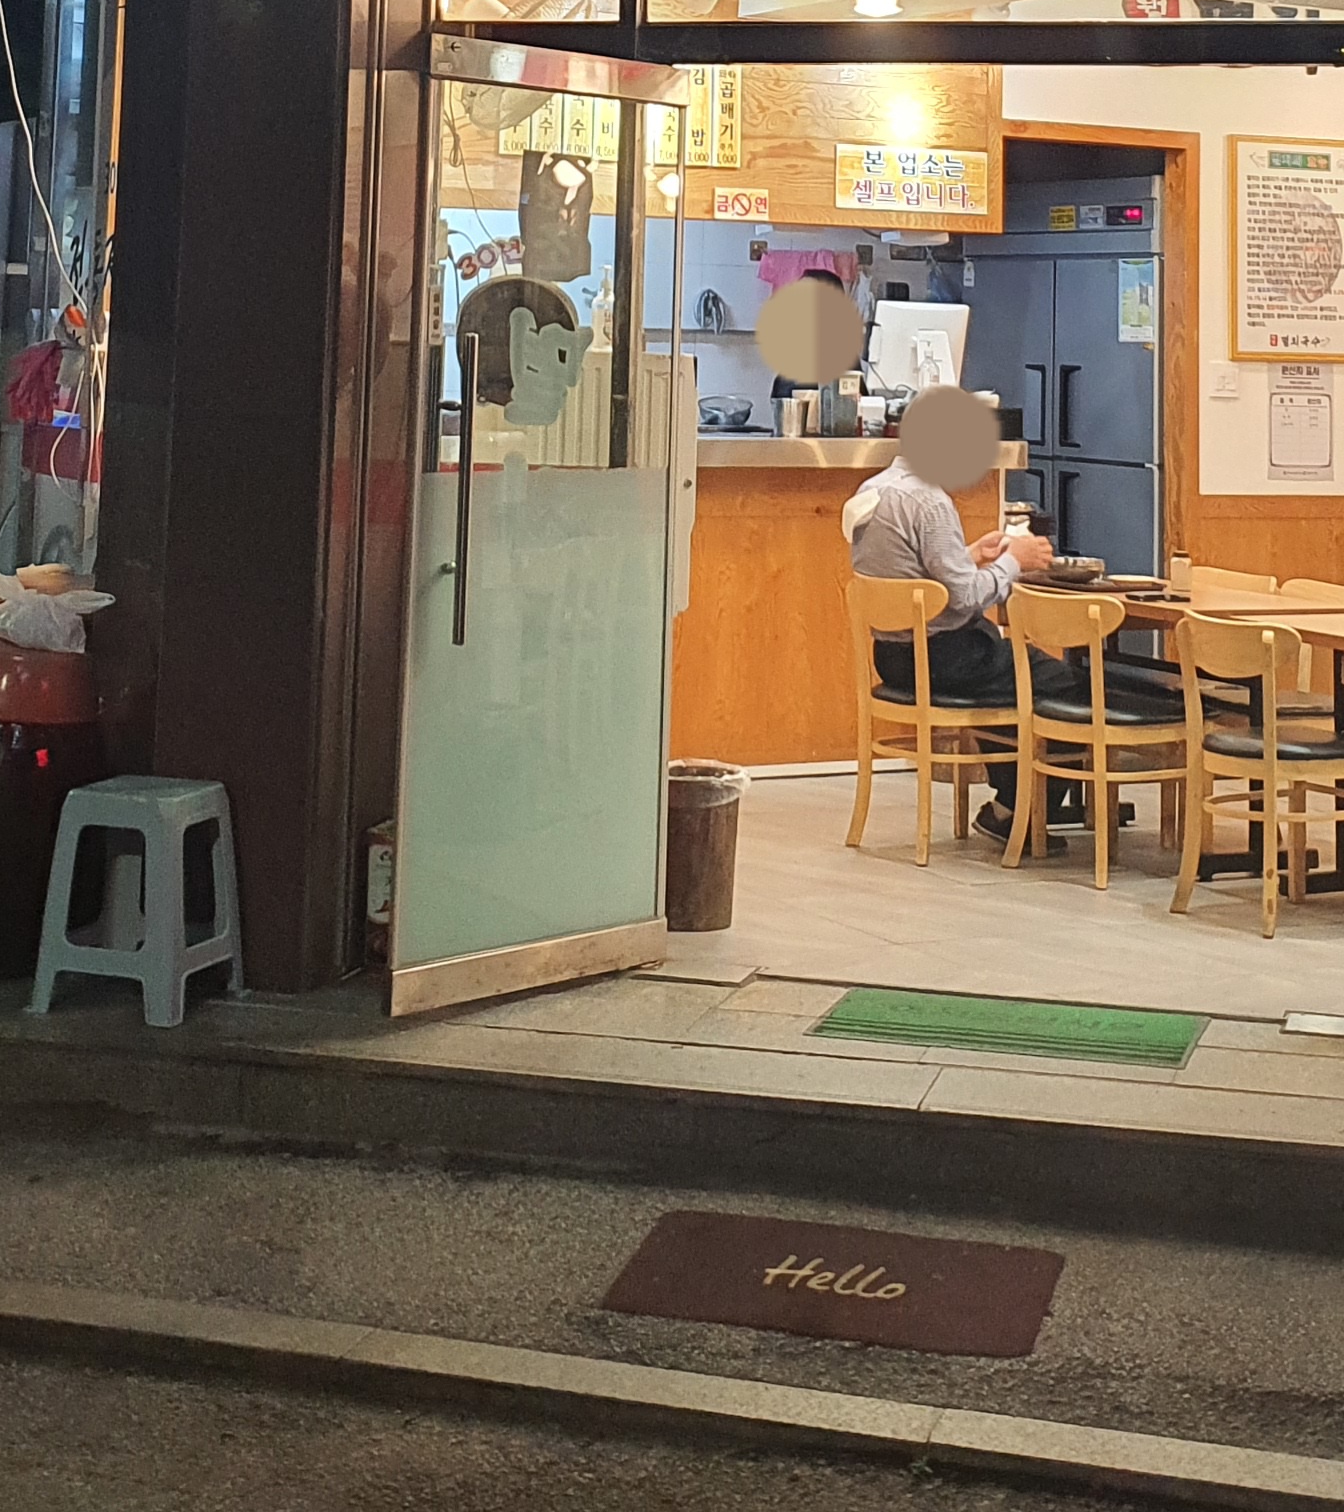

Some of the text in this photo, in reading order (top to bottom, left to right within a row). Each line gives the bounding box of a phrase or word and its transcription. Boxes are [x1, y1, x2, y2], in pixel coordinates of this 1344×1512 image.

[720, 80, 736, 142] 곱배기
[863, 149, 965, 177] 본 업소는
[762, 1254, 907, 1300] Hello
